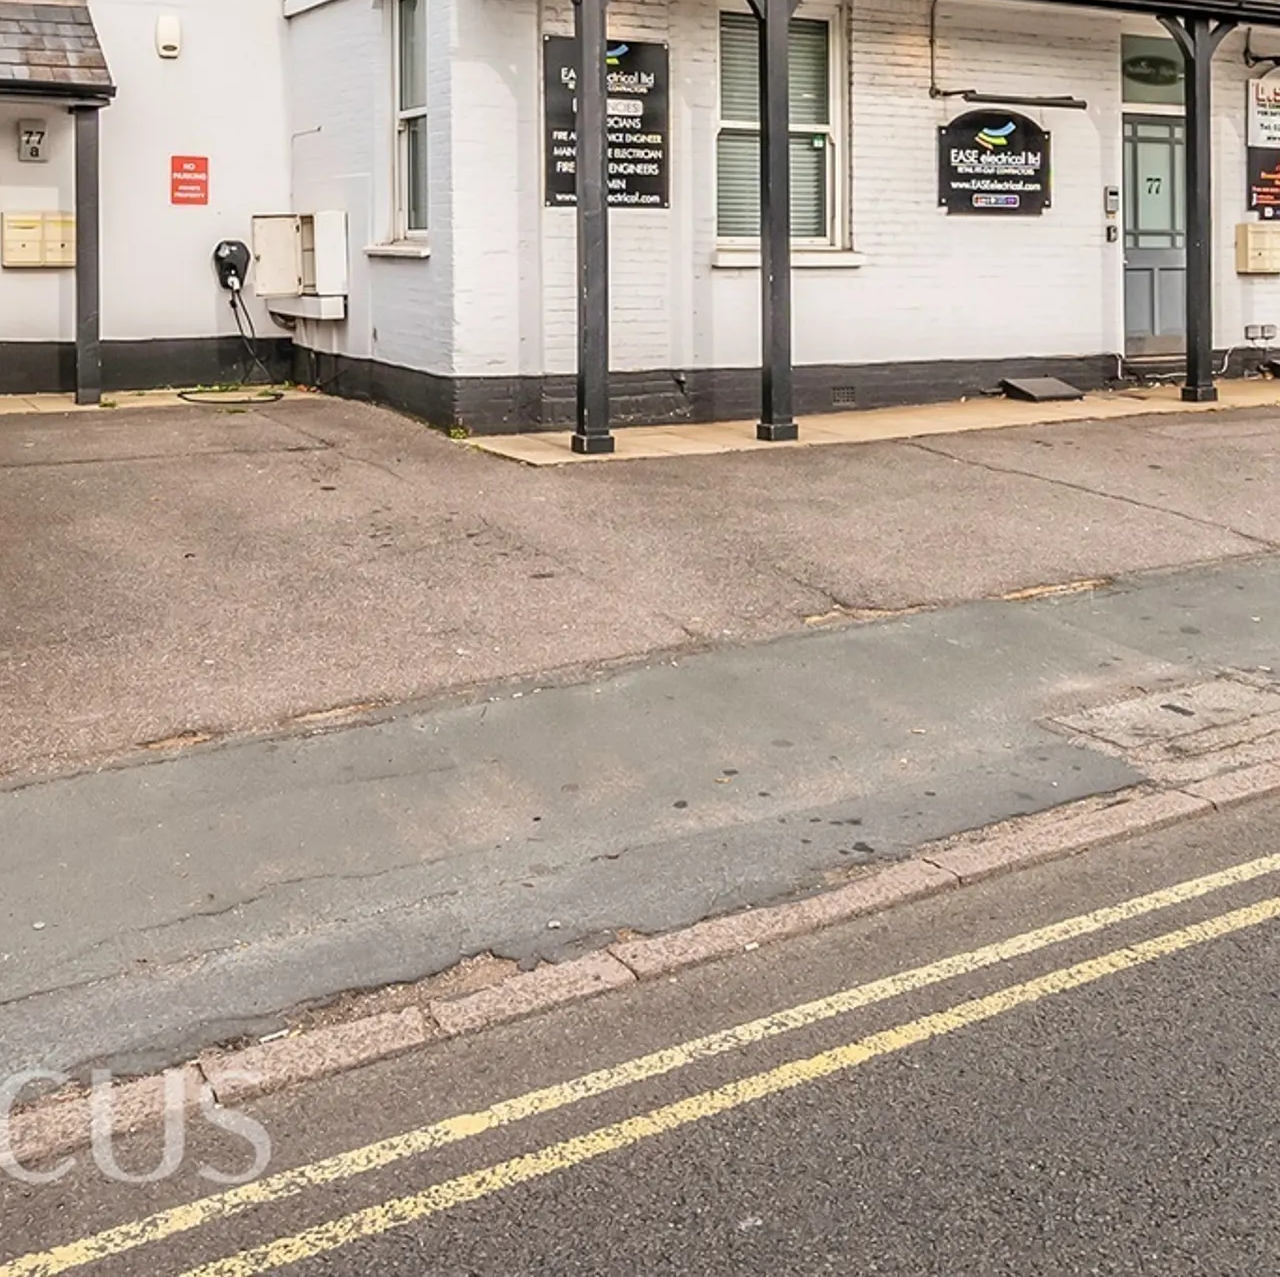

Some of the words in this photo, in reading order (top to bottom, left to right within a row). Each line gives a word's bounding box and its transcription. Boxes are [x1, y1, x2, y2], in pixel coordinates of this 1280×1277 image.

[23, 130, 46, 146] 77
[29, 146, 40, 158] a
[950, 149, 979, 164] EASE
[980, 150, 1026, 165] electrical
[1145, 178, 1162, 194] 77
